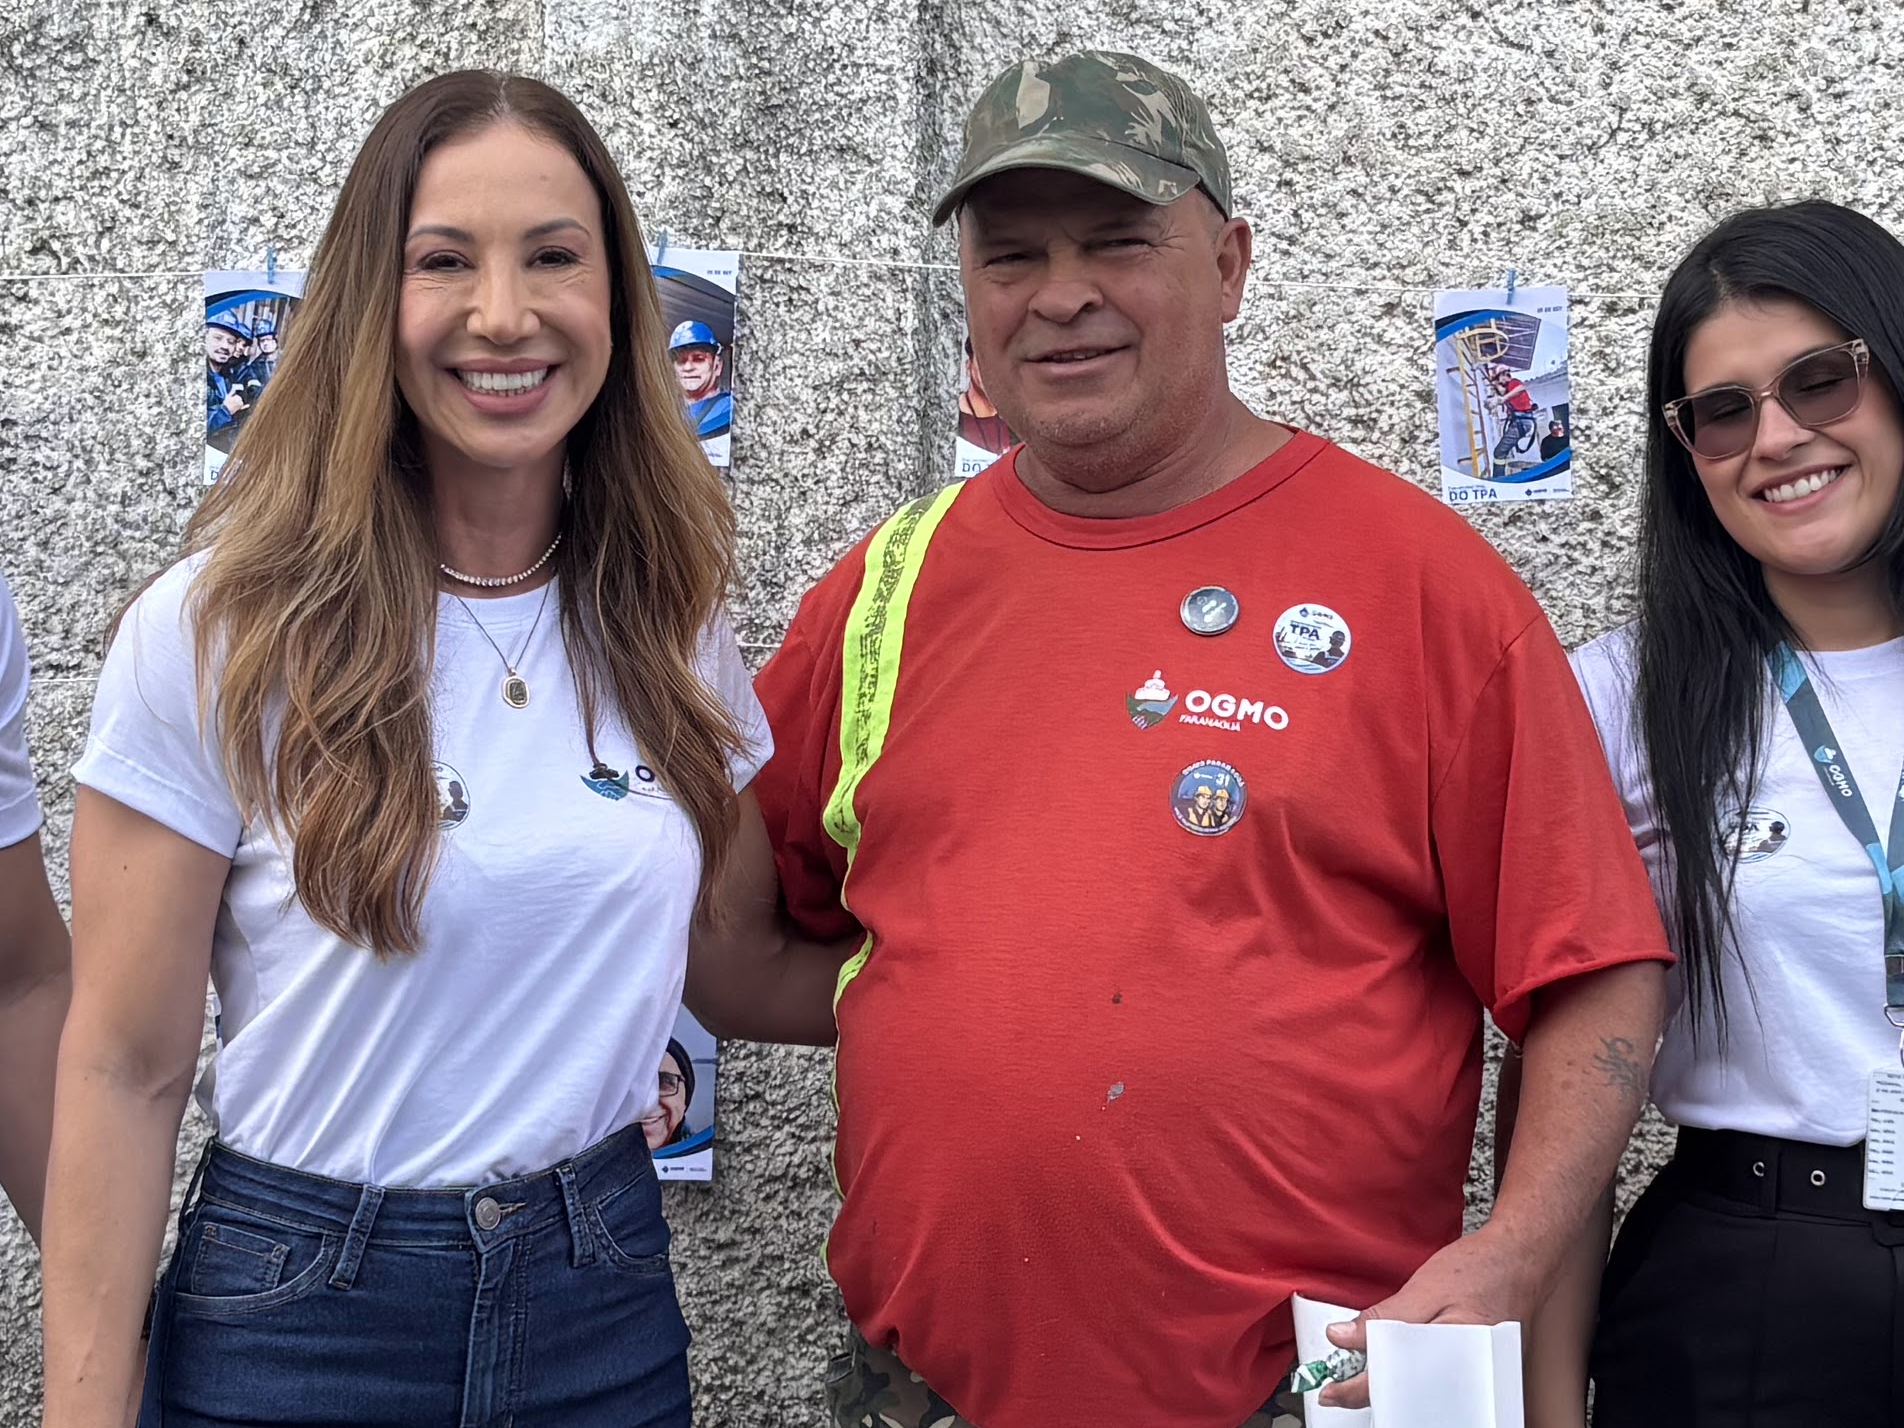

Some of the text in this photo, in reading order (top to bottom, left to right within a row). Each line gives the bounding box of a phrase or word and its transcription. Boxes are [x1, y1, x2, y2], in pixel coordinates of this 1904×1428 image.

[1449, 488, 1497, 501] DO TPA
[1290, 624, 1321, 640] TPA
[1185, 690, 1289, 730] OGMO
